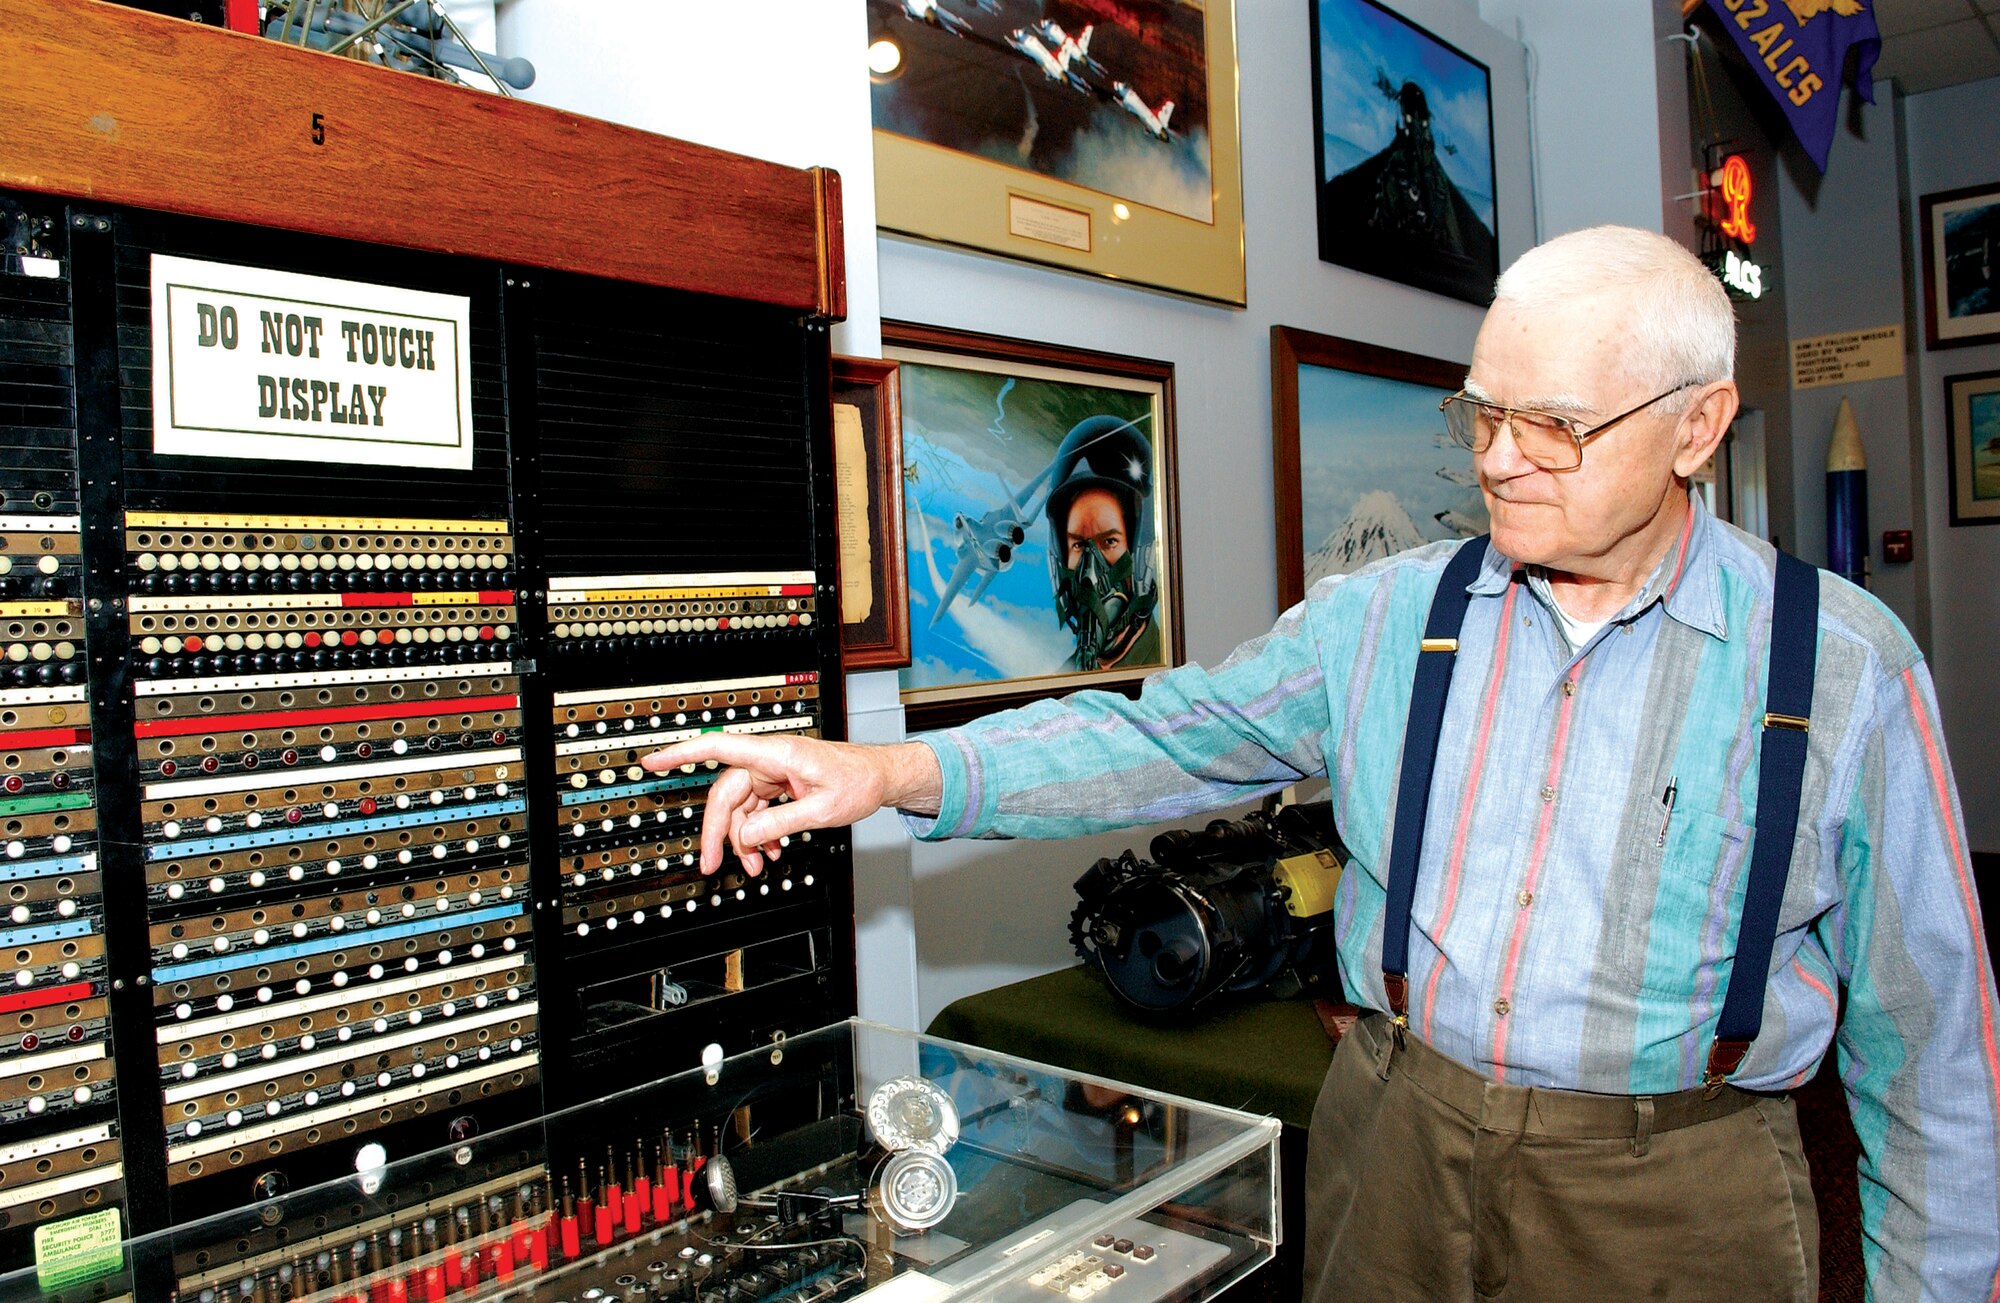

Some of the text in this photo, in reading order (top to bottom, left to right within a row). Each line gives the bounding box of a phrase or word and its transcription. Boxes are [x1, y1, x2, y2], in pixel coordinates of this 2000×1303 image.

[1748, 21, 1824, 107] ALCS
[312, 112, 325, 146] 5
[197, 302, 435, 371] DO NOT TOUCH
[257, 374, 387, 427] DISPLAY
[789, 674, 814, 683] RADIO
[888, 1086, 896, 1095] 4
[877, 1095, 886, 1105] 5
[874, 1110, 883, 1119] 6
[878, 1124, 885, 1136] 7
[890, 1138, 900, 1149] 8
[41, 1236, 54, 1245] FIRE
[88, 1224, 103, 1233] DIAL
[50, 1217, 108, 1236] EMERGENCY NUMBERS
[42, 1239, 72, 1252] SECURITY
[73, 1232, 94, 1244] POLICE
[43, 1243, 82, 1259] AMBULANCE
